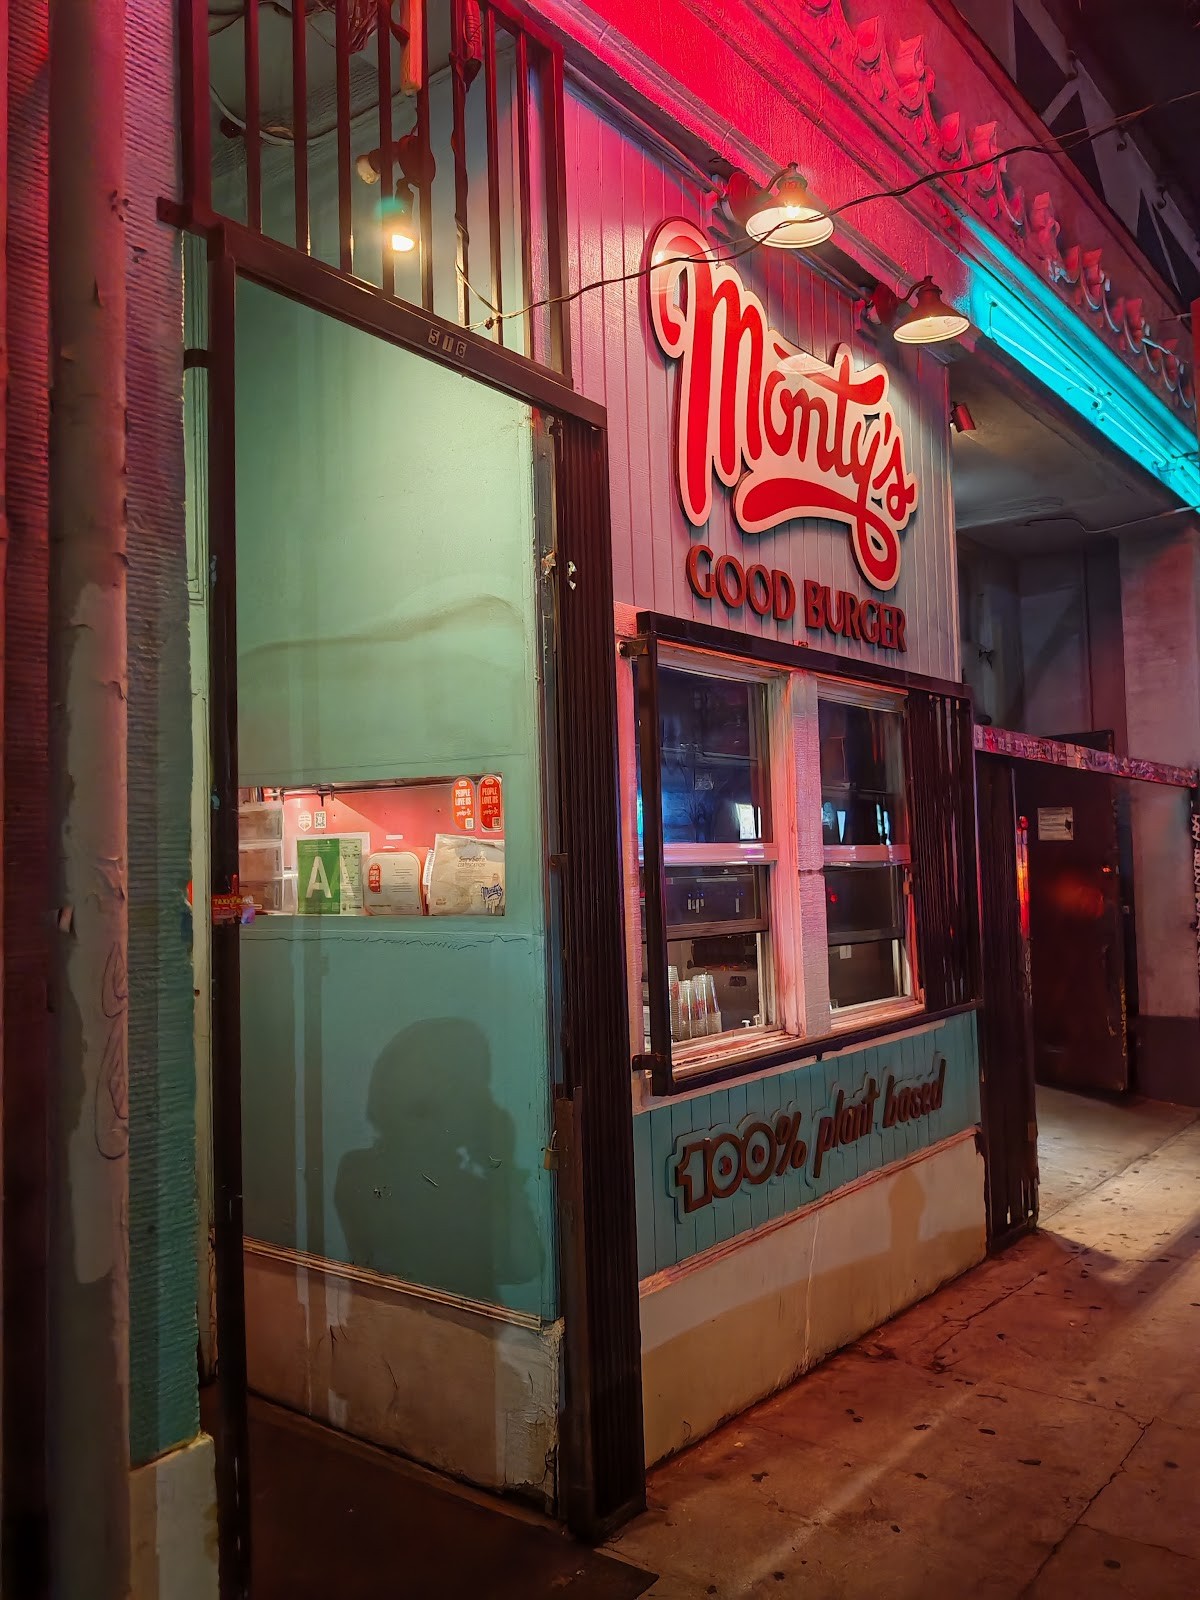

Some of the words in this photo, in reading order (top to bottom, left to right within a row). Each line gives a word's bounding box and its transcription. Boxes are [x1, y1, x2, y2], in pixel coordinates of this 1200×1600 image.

[430, 330, 466, 356] 516
[656, 228, 915, 585] Monty's
[686, 545, 796, 621] GOOD
[804, 579, 907, 652] BURGER
[455, 789, 471, 797] PEOPLE
[455, 797, 466, 806] LOVE
[465, 797, 472, 805] US
[481, 796, 492, 805] LOVE
[492, 796, 499, 804] US
[482, 787, 498, 795] PEOPLE
[305, 855, 333, 899] A
[675, 1110, 808, 1214] 100%
[812, 1077, 880, 1179] plant
[882, 1058, 947, 1129] based
